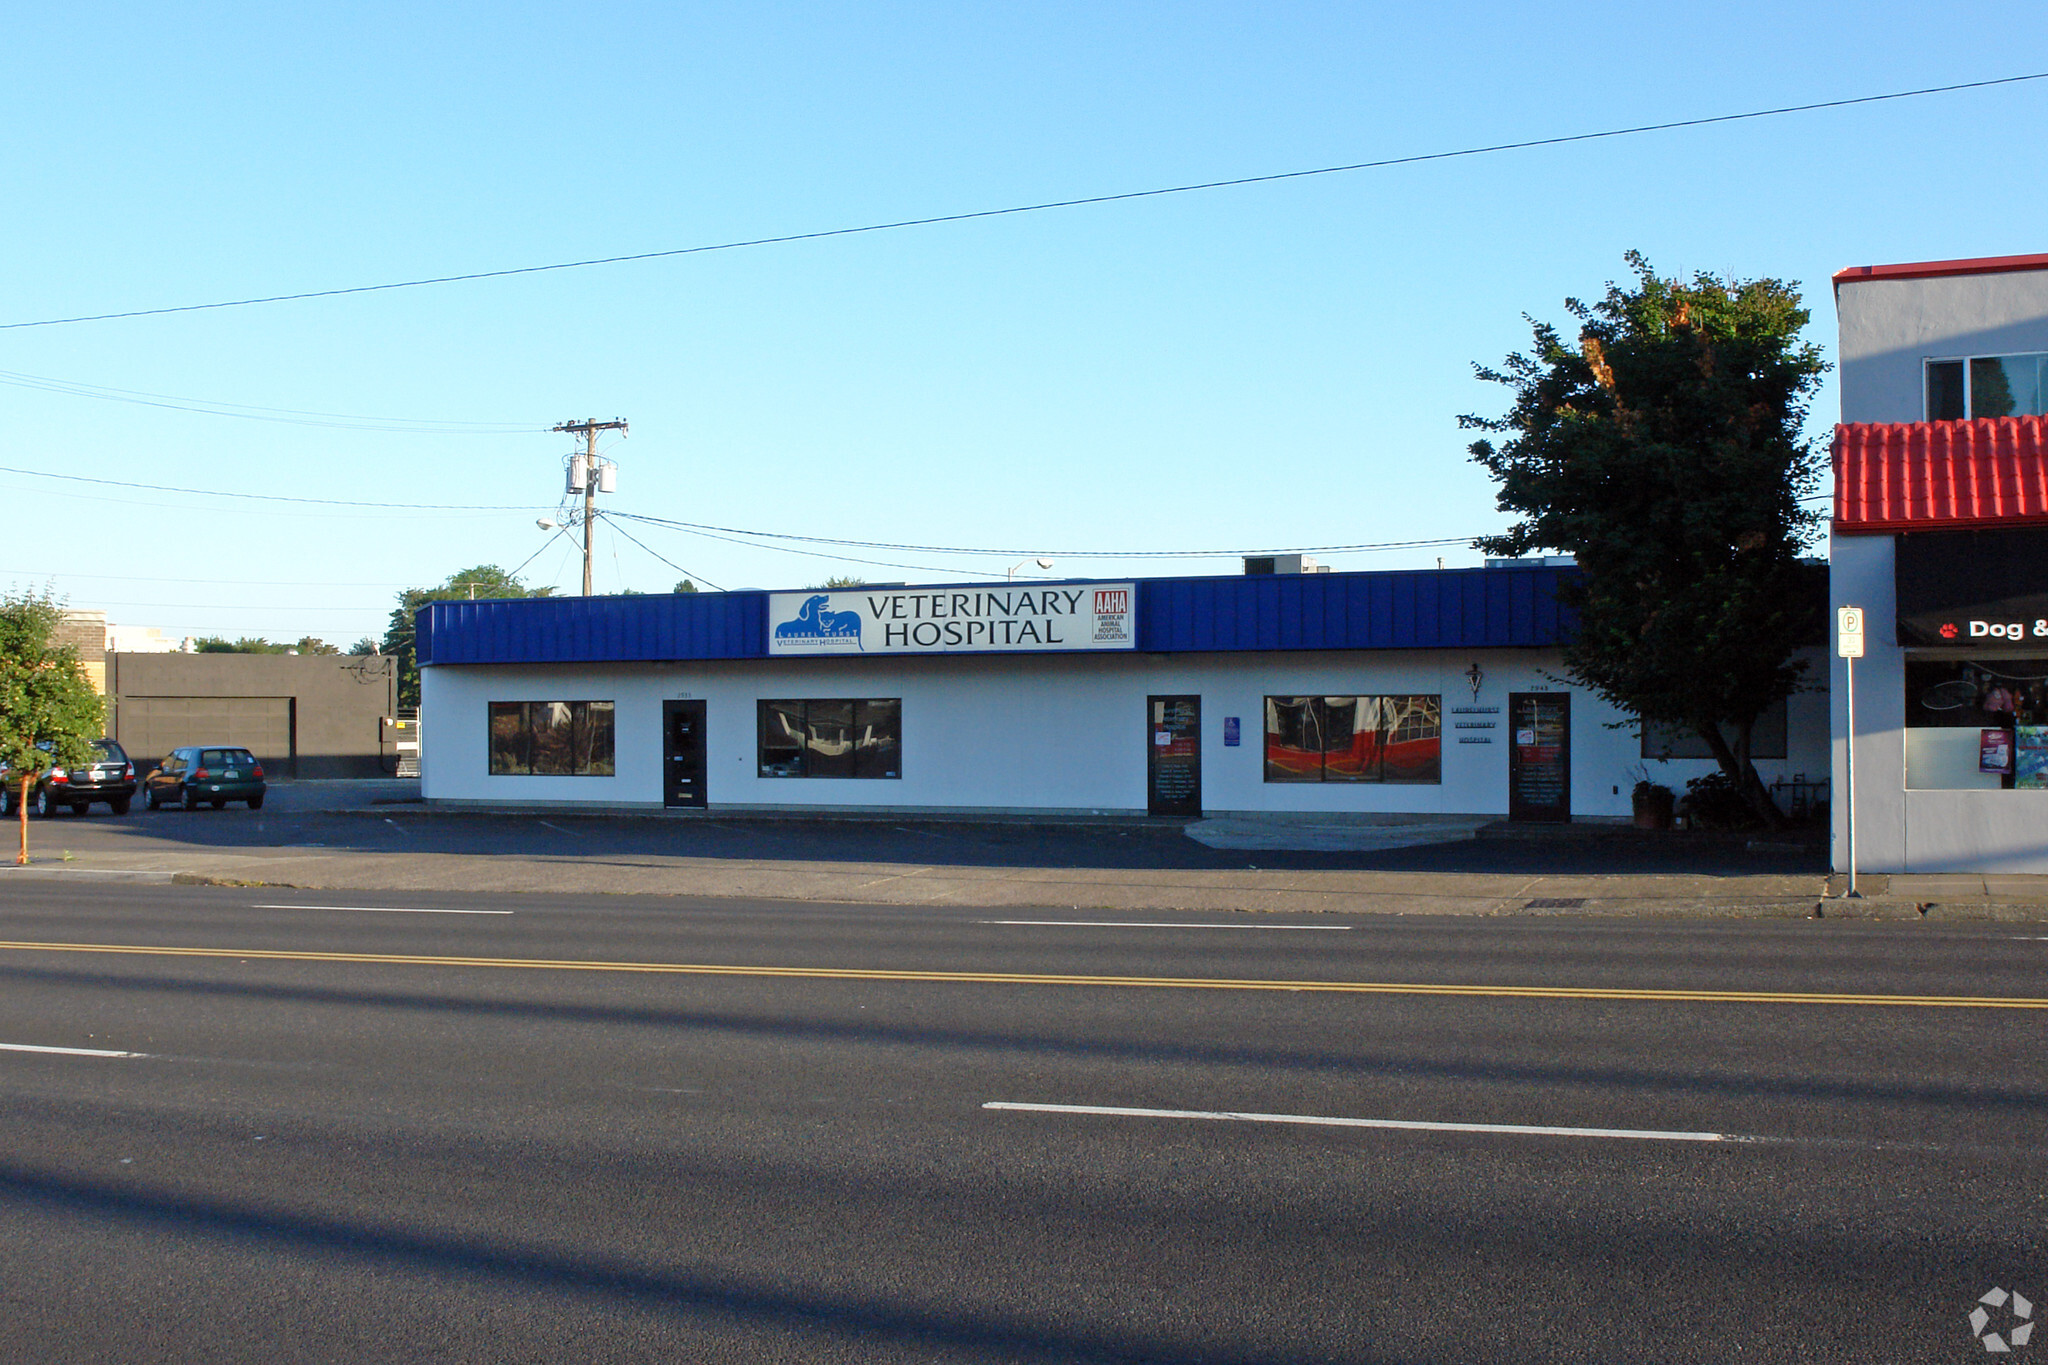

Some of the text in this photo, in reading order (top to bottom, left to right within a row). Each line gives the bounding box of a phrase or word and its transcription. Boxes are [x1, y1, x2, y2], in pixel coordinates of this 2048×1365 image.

[868, 591, 1085, 619] VETERINARY
[1096, 592, 1126, 613] AAHA
[885, 619, 1063, 646] HOSPITAL
[1969, 620, 2024, 641] Dog
[777, 638, 853, 647] VETERINARY HOSPITAL
[1458, 736, 1492, 744] HOSPITAL
